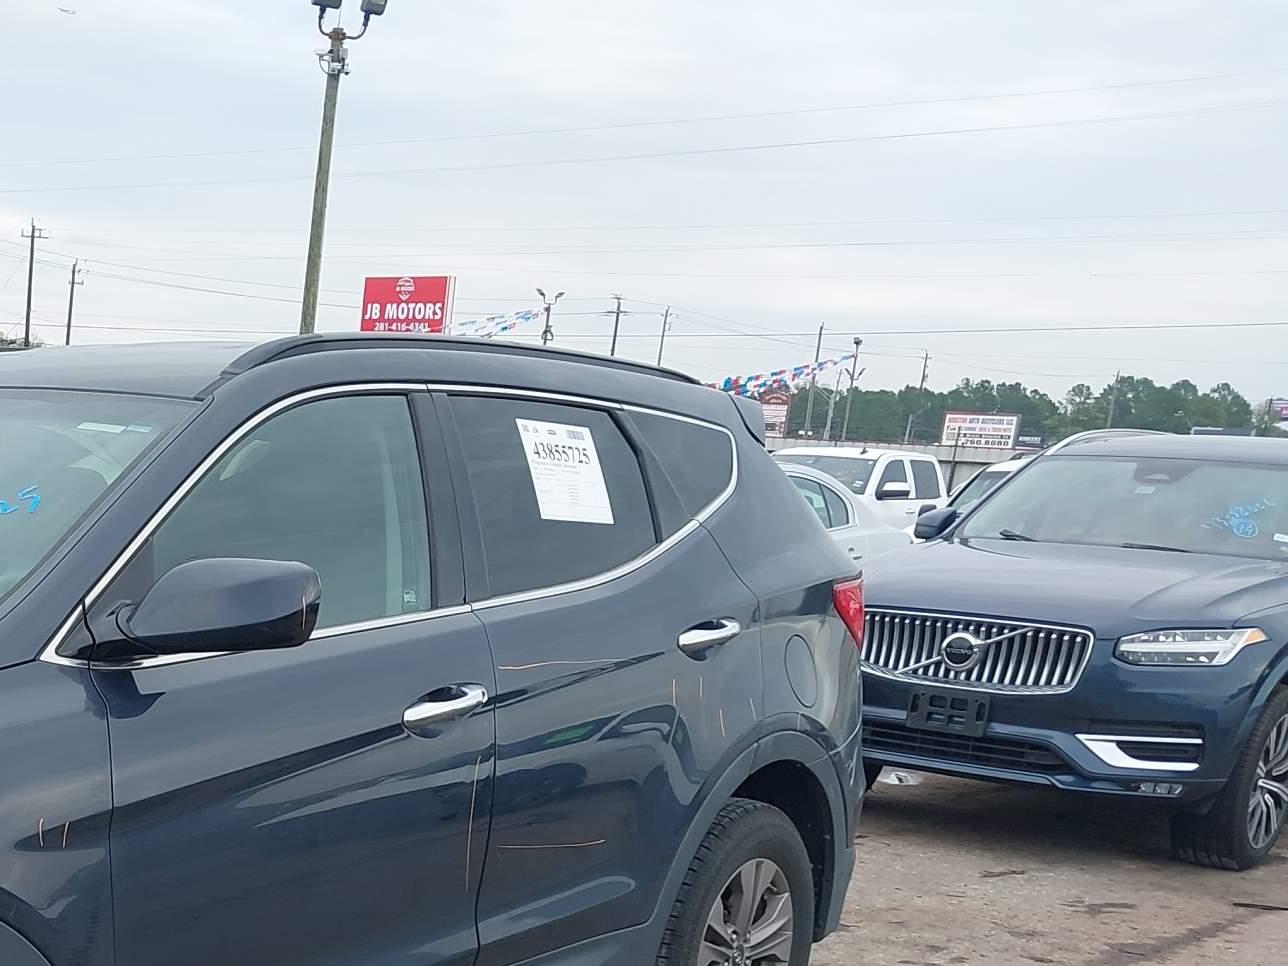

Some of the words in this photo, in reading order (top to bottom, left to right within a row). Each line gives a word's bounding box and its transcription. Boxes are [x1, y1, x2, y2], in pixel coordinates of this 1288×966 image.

[364, 302, 381, 320] JB
[384, 302, 442, 320] MOTORS
[533, 441, 591, 465] 43855725
